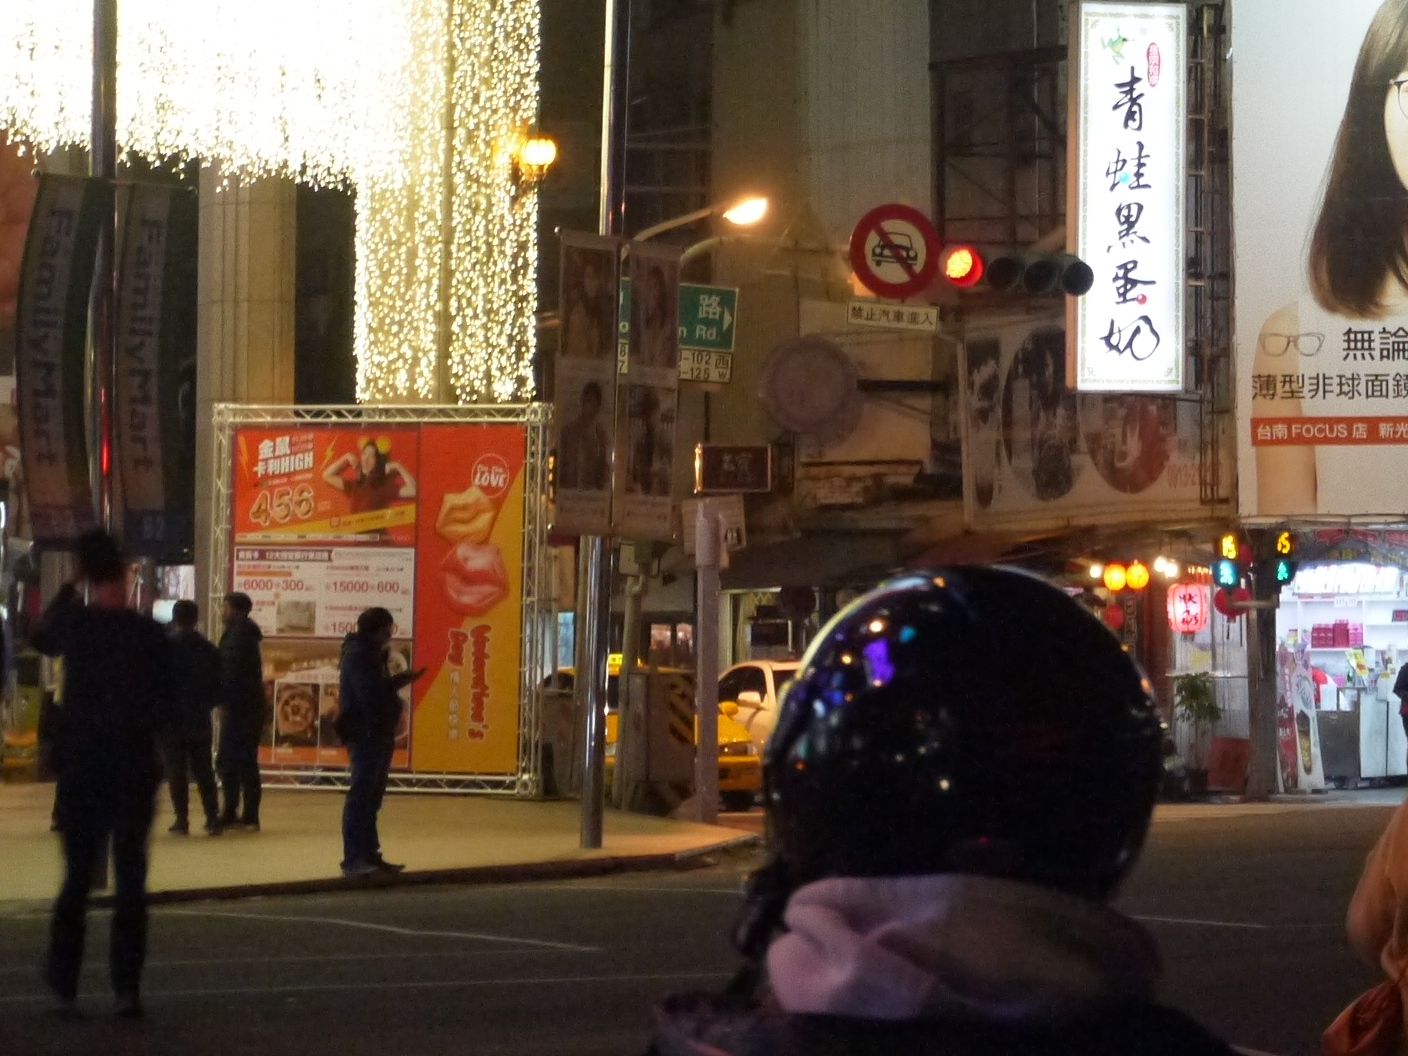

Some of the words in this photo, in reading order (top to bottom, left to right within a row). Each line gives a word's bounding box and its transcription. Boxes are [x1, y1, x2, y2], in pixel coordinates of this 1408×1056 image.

[1099, 65, 1161, 361] 青蛙黑蛋奶
[698, 293, 722, 320] 路
[851, 305, 934, 327] 禁止汽車進入
[695, 324, 720, 341] Rd.
[1257, 424, 1288, 440] 台南
[1292, 424, 1348, 438] FOCUS
